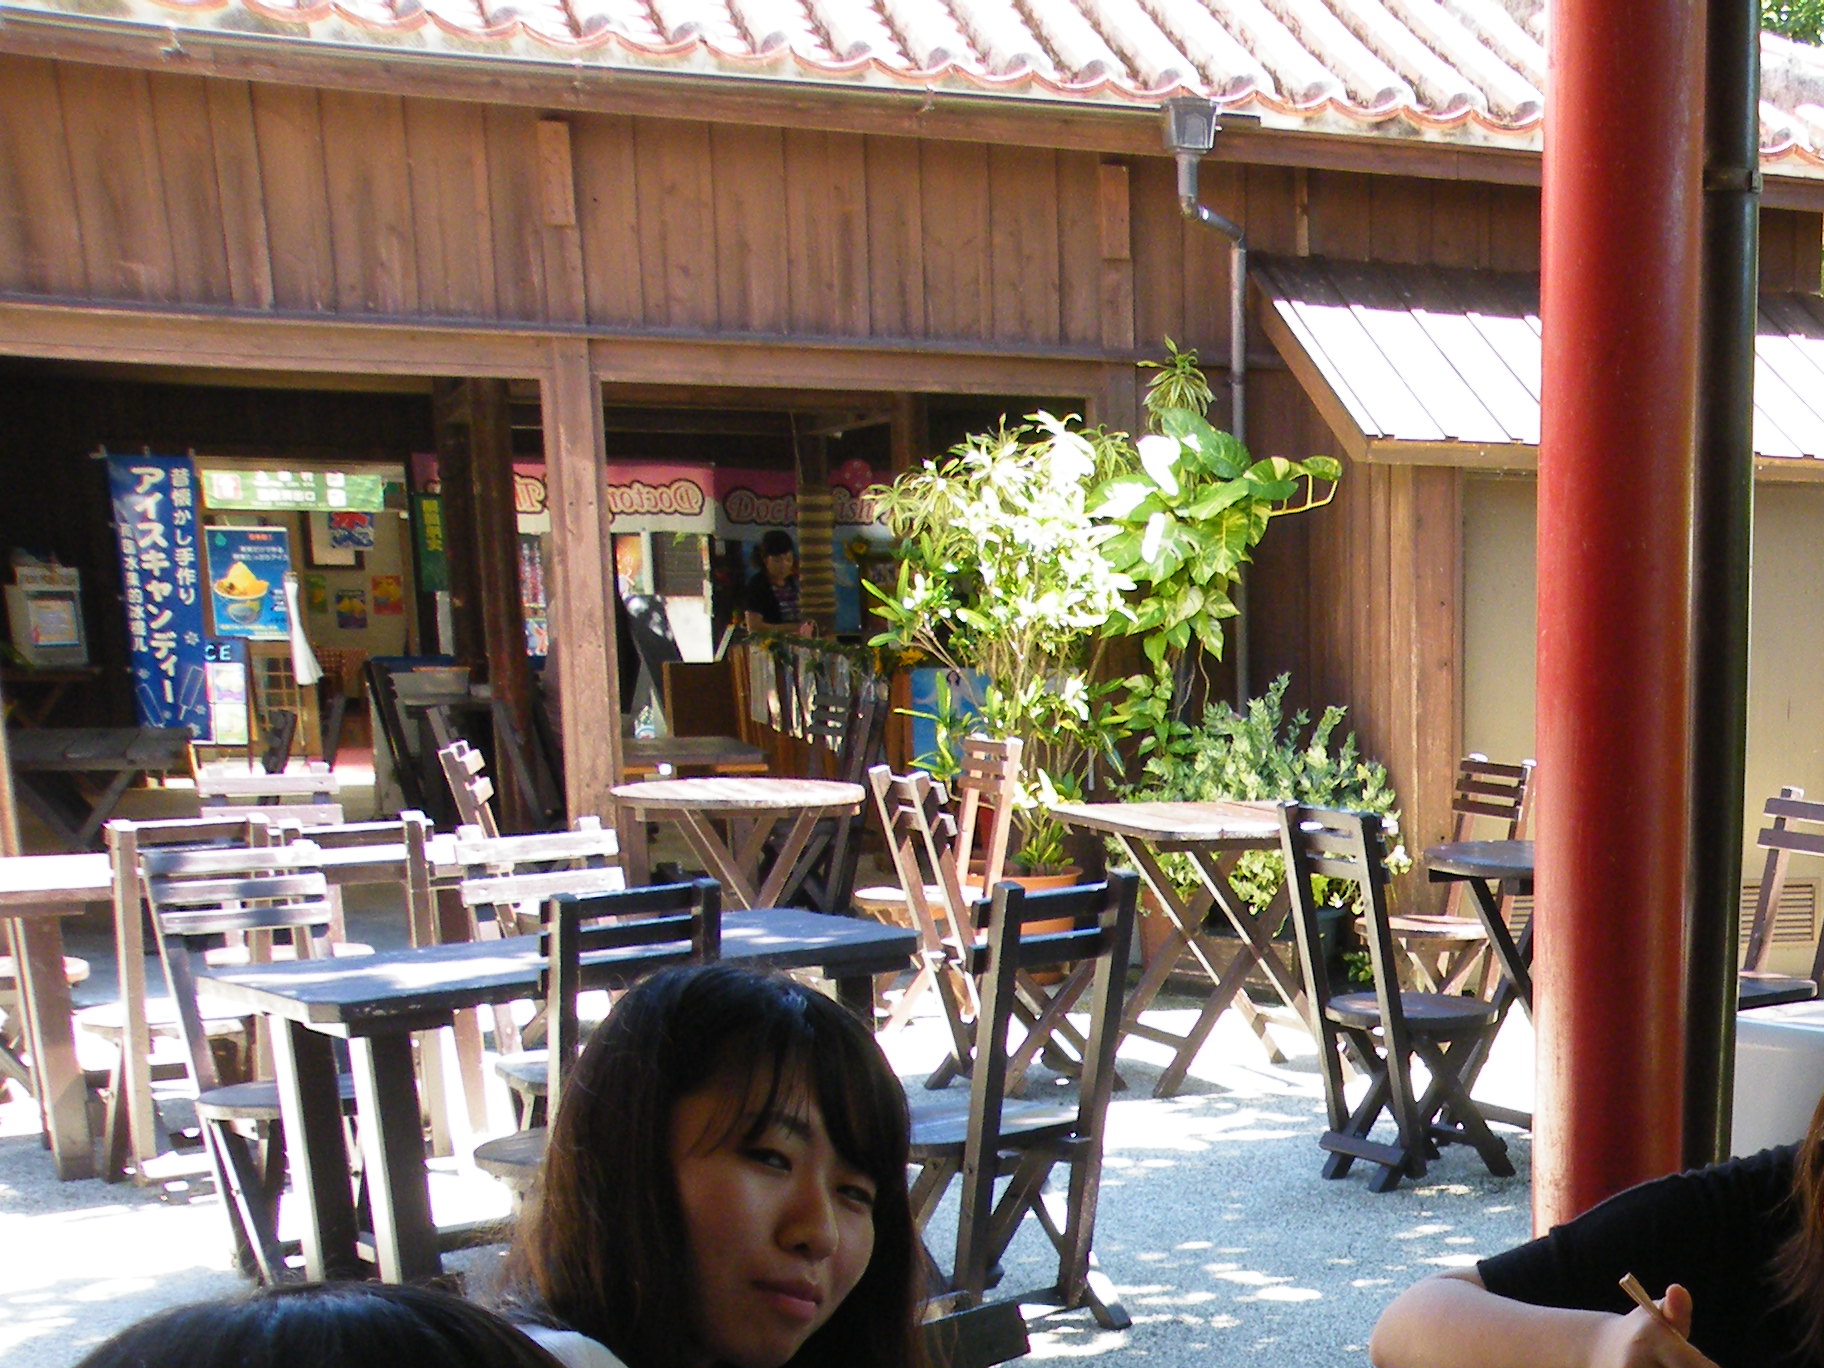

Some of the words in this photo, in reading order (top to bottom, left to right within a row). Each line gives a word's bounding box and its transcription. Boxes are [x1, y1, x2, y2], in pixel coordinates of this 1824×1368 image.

[130, 466, 178, 704] アイスキャンディー
